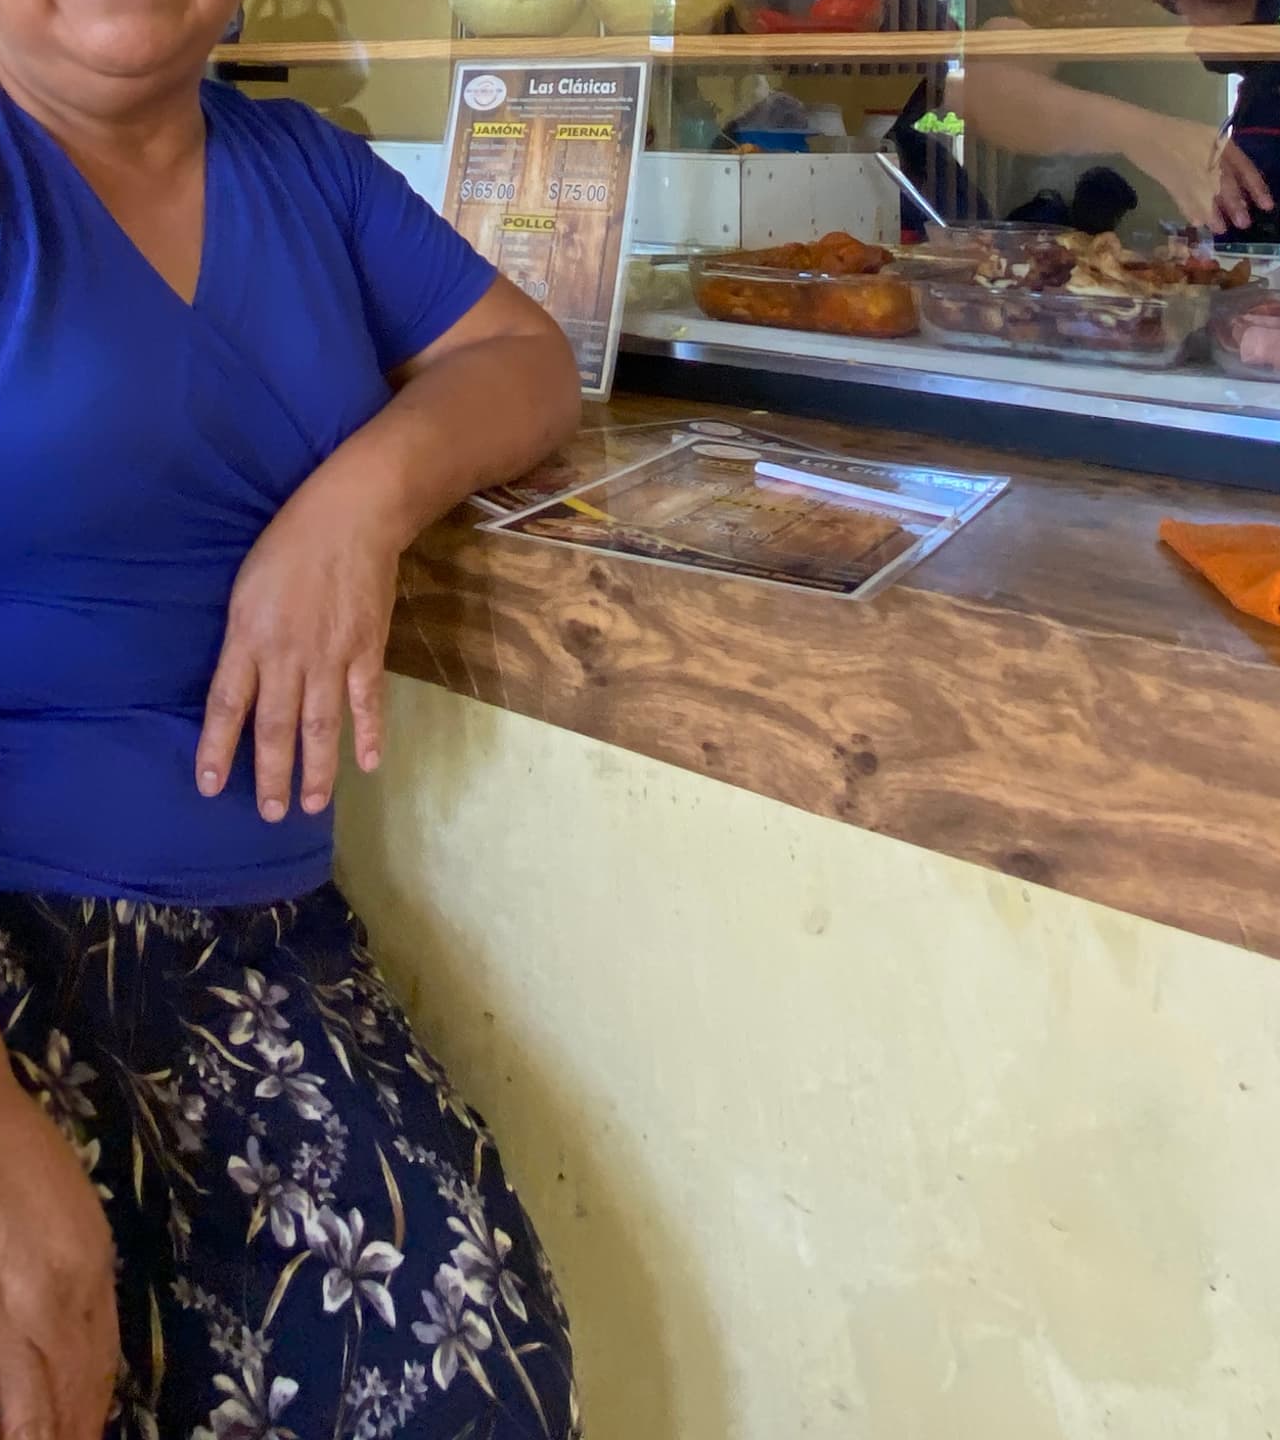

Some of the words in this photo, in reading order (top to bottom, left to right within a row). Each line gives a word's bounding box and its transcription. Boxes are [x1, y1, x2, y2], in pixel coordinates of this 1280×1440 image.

[529, 78, 554, 95] Las
[558, 77, 617, 95] Clásicas
[475, 123, 522, 136] JAMÓN
[559, 126, 610, 138] PIERNA
[564, 183, 607, 202] 75.00
[503, 217, 556, 230] POLLO
